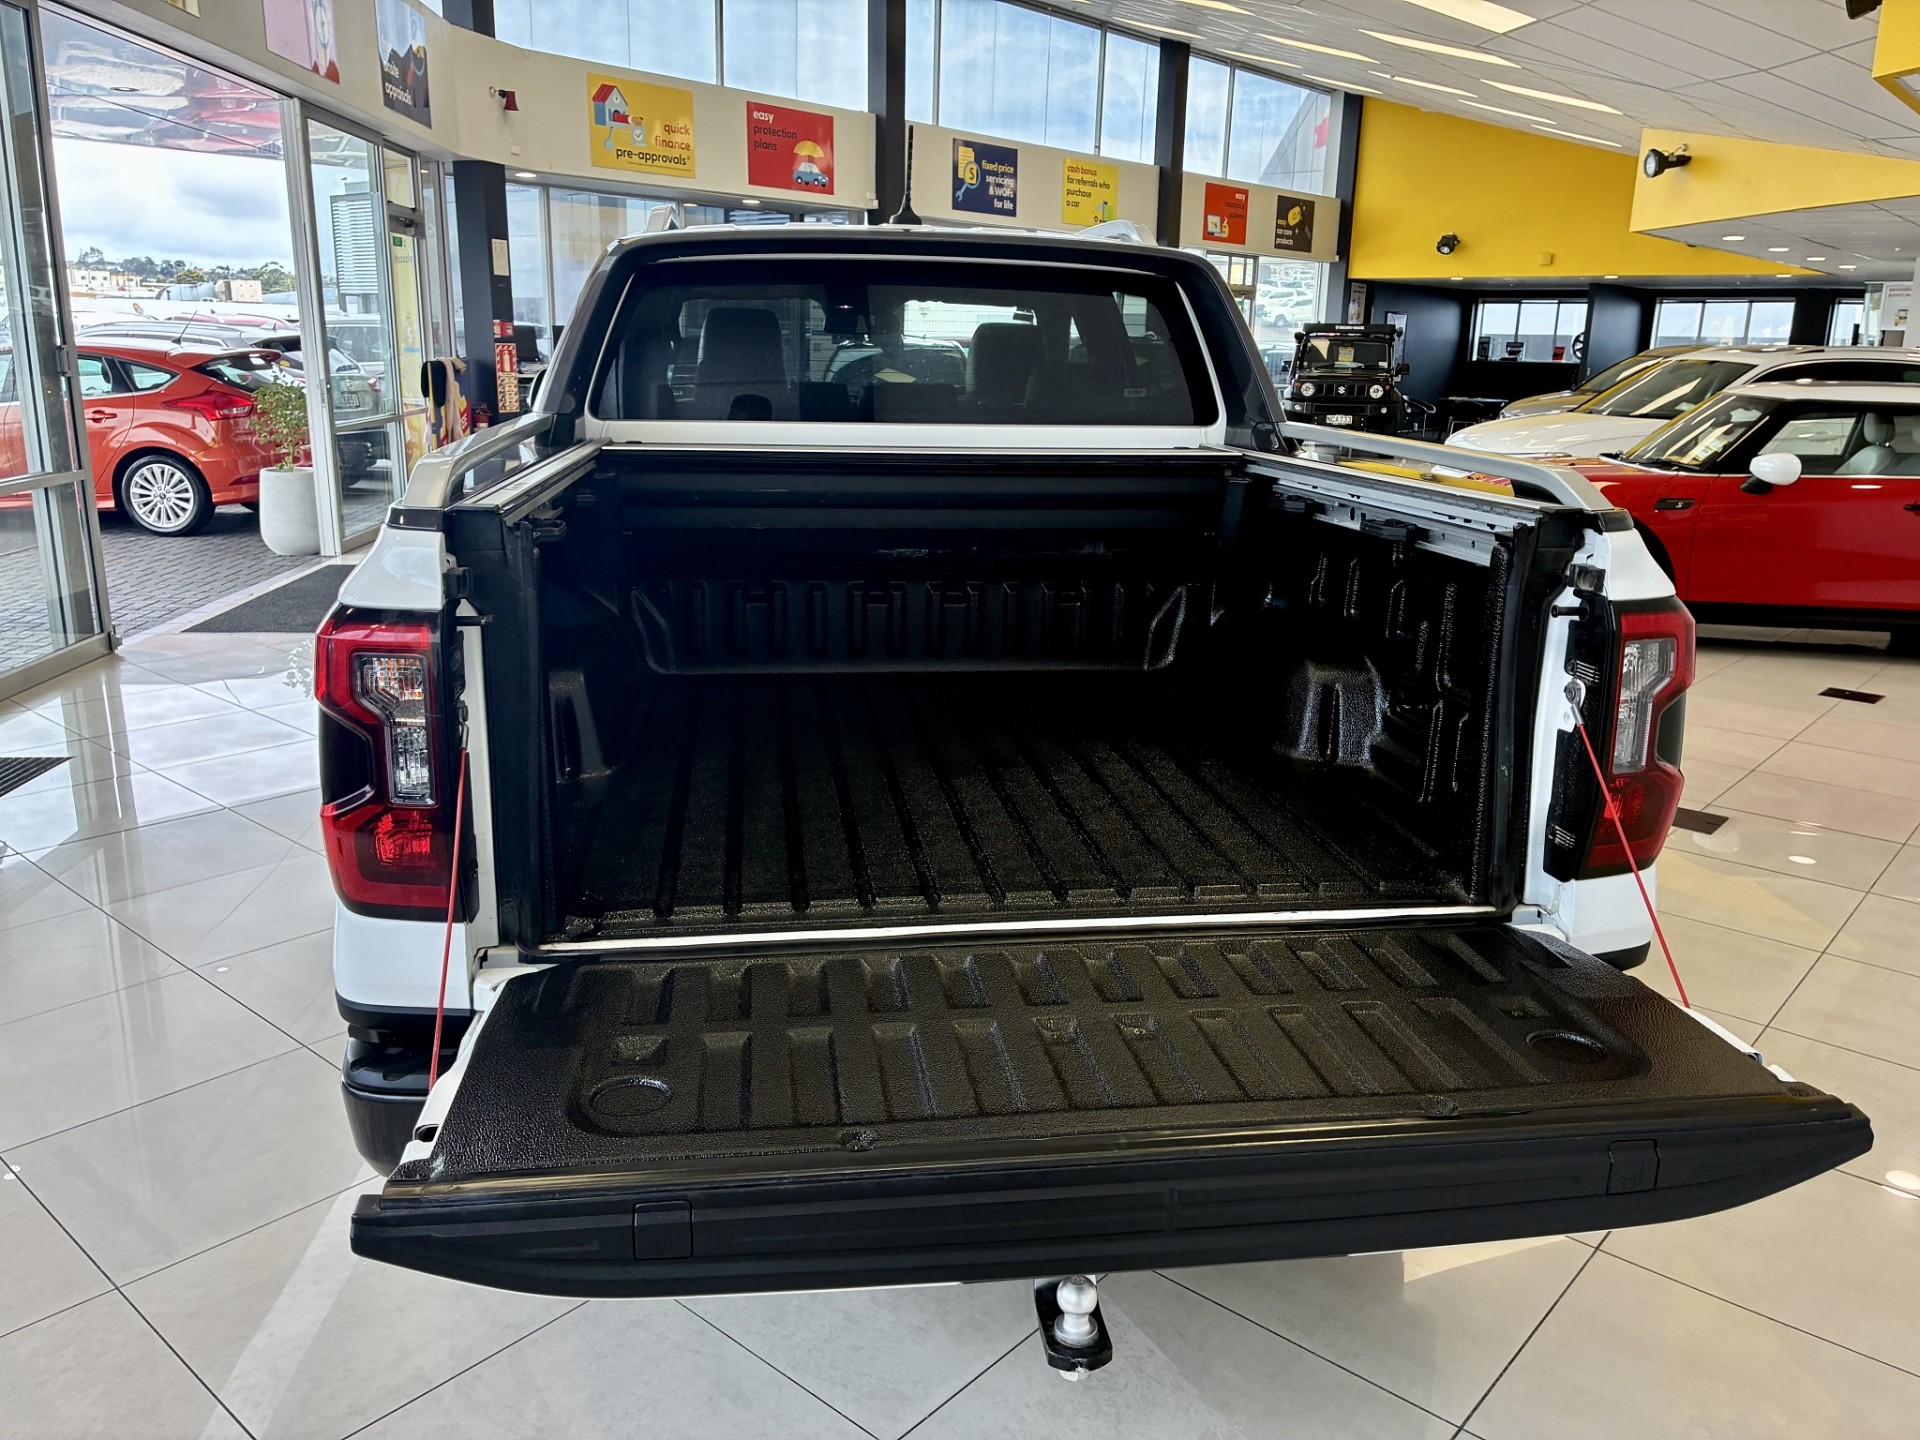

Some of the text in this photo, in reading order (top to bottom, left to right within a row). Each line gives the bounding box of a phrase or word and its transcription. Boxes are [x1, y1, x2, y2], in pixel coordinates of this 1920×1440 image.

[383, 61, 399, 79] onsite
[384, 82, 412, 105] appraisals
[753, 111, 774, 124] easy
[664, 123, 691, 136] quick
[753, 125, 798, 139] protection
[654, 135, 691, 151] finance
[753, 139, 778, 151] plans
[981, 160, 1014, 174] fixed price
[1067, 165, 1098, 177] cash bonus
[986, 175, 1014, 188] servicing
[1066, 174, 1111, 190] for referrals who
[989, 187, 1014, 198] & WOFs
[1066, 188, 1092, 199] purchase
[994, 199, 1014, 210] for life
[1071, 200, 1080, 208] car
